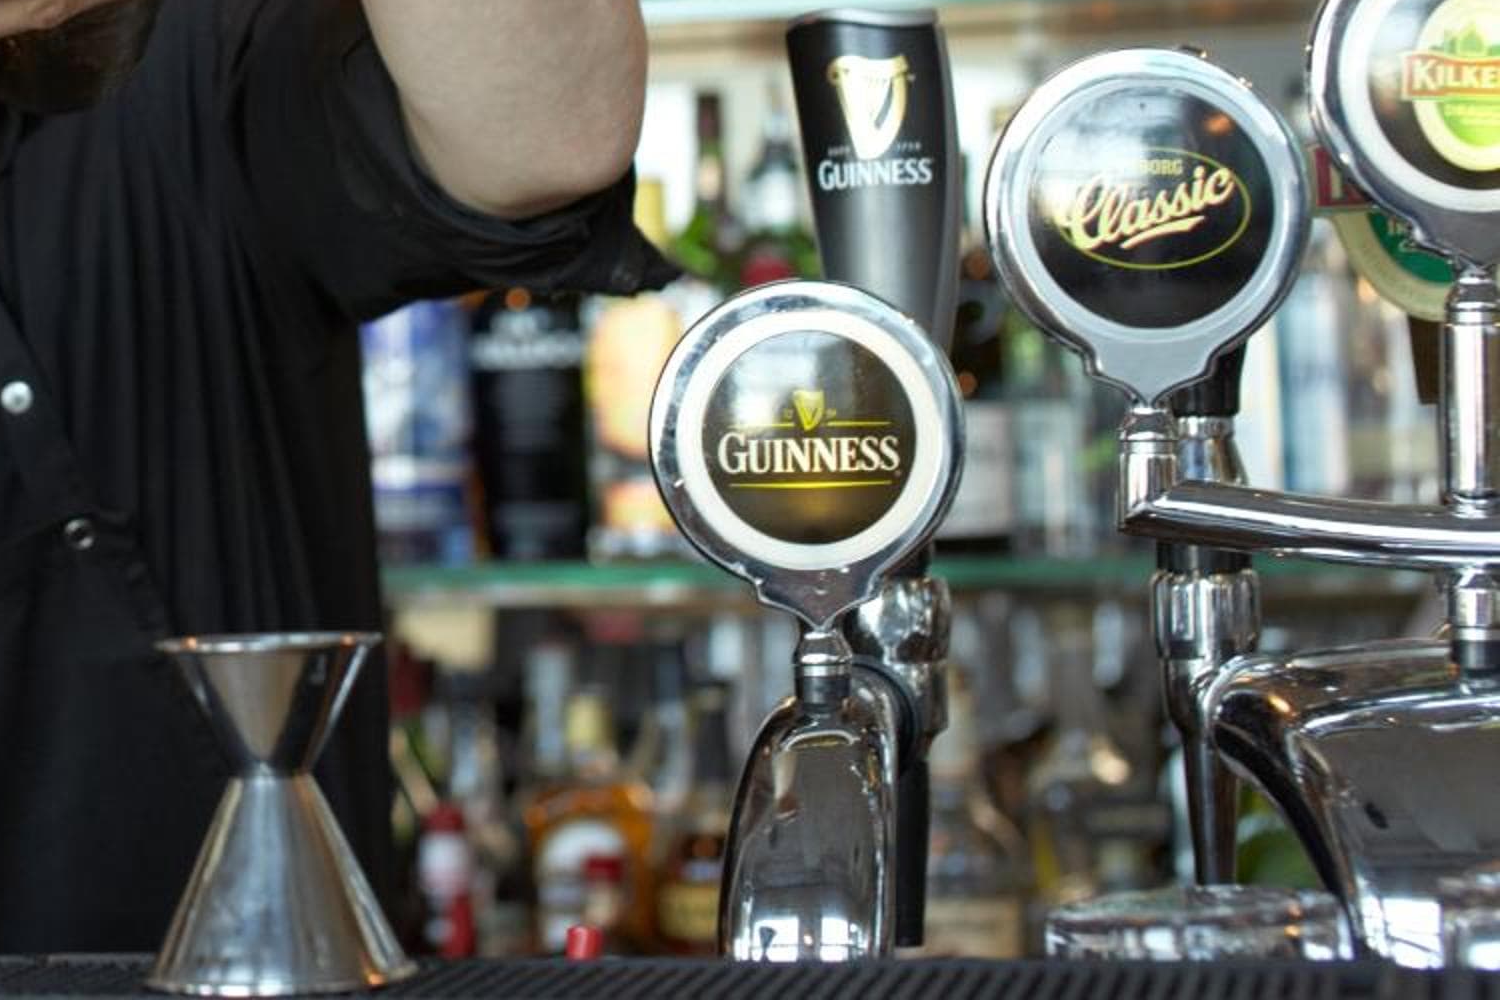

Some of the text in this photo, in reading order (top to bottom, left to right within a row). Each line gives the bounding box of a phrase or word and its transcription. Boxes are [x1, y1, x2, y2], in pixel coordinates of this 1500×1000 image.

[818, 159, 933, 190] GUINNESS
[1060, 165, 1235, 251] Classic
[718, 432, 900, 474] GUINNESS
